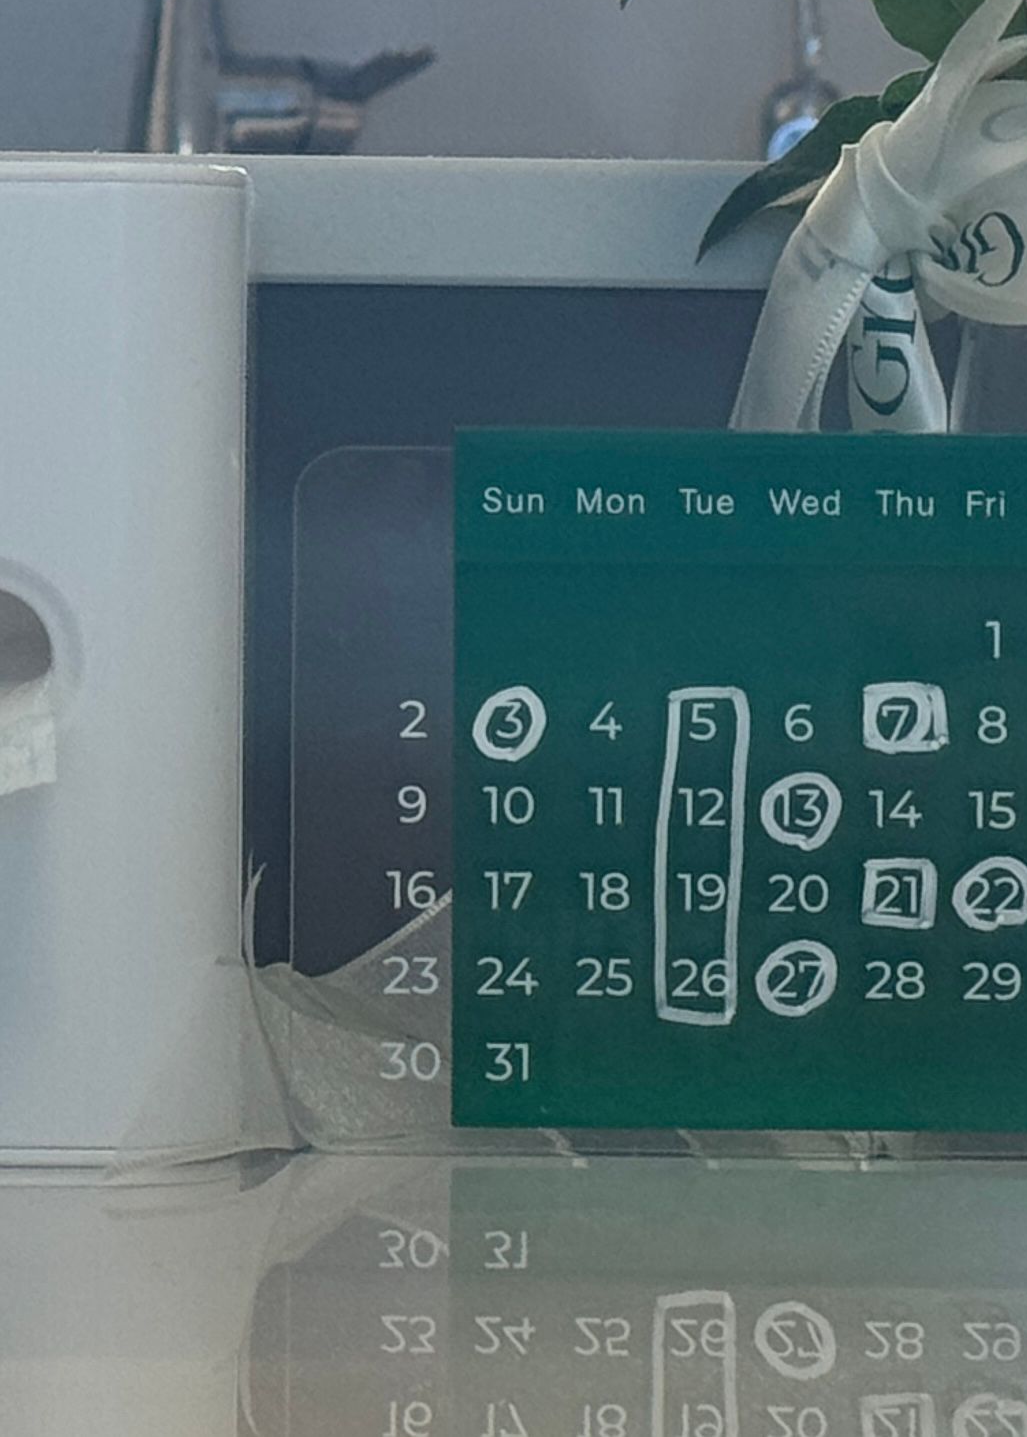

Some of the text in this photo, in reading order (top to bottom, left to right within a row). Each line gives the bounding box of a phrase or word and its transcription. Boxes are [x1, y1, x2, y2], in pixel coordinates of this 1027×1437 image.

[483, 487, 543, 513] Sun
[578, 488, 644, 513] Mon
[679, 489, 733, 514] Tue
[770, 489, 840, 515] Wed
[876, 490, 933, 516] Thu
[967, 491, 1004, 516] Fri
[986, 621, 1000, 658] 1
[400, 701, 427, 737] 2
[498, 702, 523, 739] 3
[590, 702, 622, 739] 4
[690, 703, 716, 740] 5
[785, 704, 813, 741] 6
[882, 705, 911, 743] 7
[978, 706, 1007, 743] 8
[399, 786, 426, 823] 9
[483, 787, 534, 824] 10
[589, 788, 622, 824] 11
[679, 789, 727, 826] 12
[779, 790, 823, 828] 13
[869, 790, 922, 827] 14
[969, 791, 1015, 829] 15
[387, 872, 437, 910] 16
[485, 872, 532, 909] 17
[580, 873, 629, 910] 18
[677, 873, 728, 911] 19
[769, 874, 828, 912] 20
[876, 876, 917, 913] 21
[967, 877, 1022, 913] 22
[383, 957, 438, 994] 23
[478, 957, 538, 995] 24
[577, 958, 632, 996] 25
[671, 961, 731, 997] 26
[769, 961, 824, 999] 27
[866, 961, 924, 999] 28
[963, 963, 1020, 1000] 29
[380, 1042, 528, 1080] 30 31
